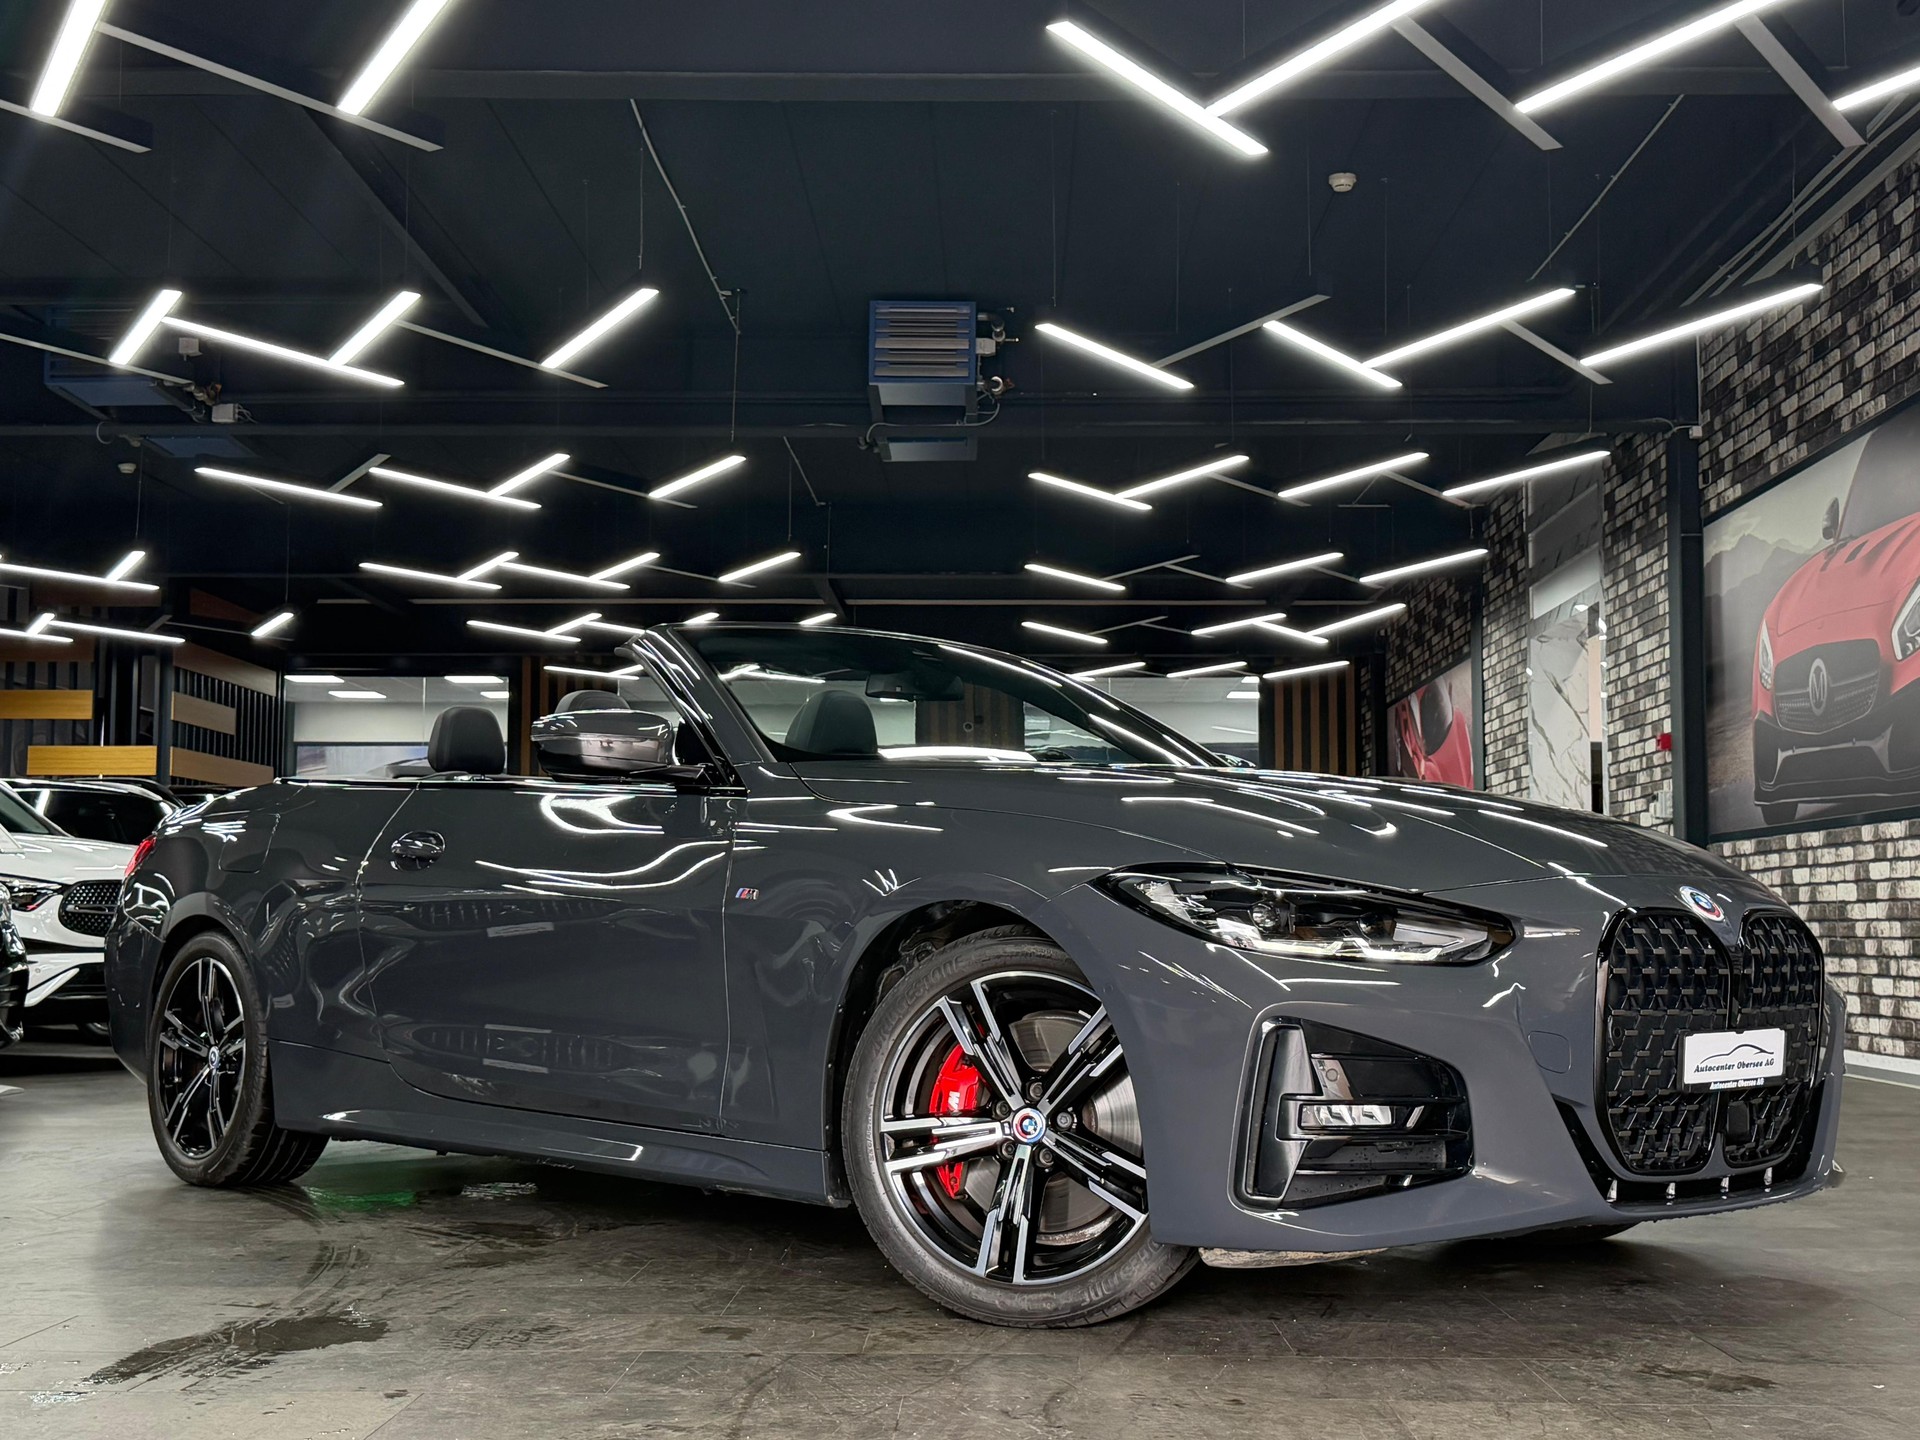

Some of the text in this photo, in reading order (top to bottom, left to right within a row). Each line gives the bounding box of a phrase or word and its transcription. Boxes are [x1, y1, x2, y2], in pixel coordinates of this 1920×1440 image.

[1694, 1058, 1774, 1073] Autocenter Obersee AG
[1709, 1077, 1764, 1090] Autocenter Obersee AG
